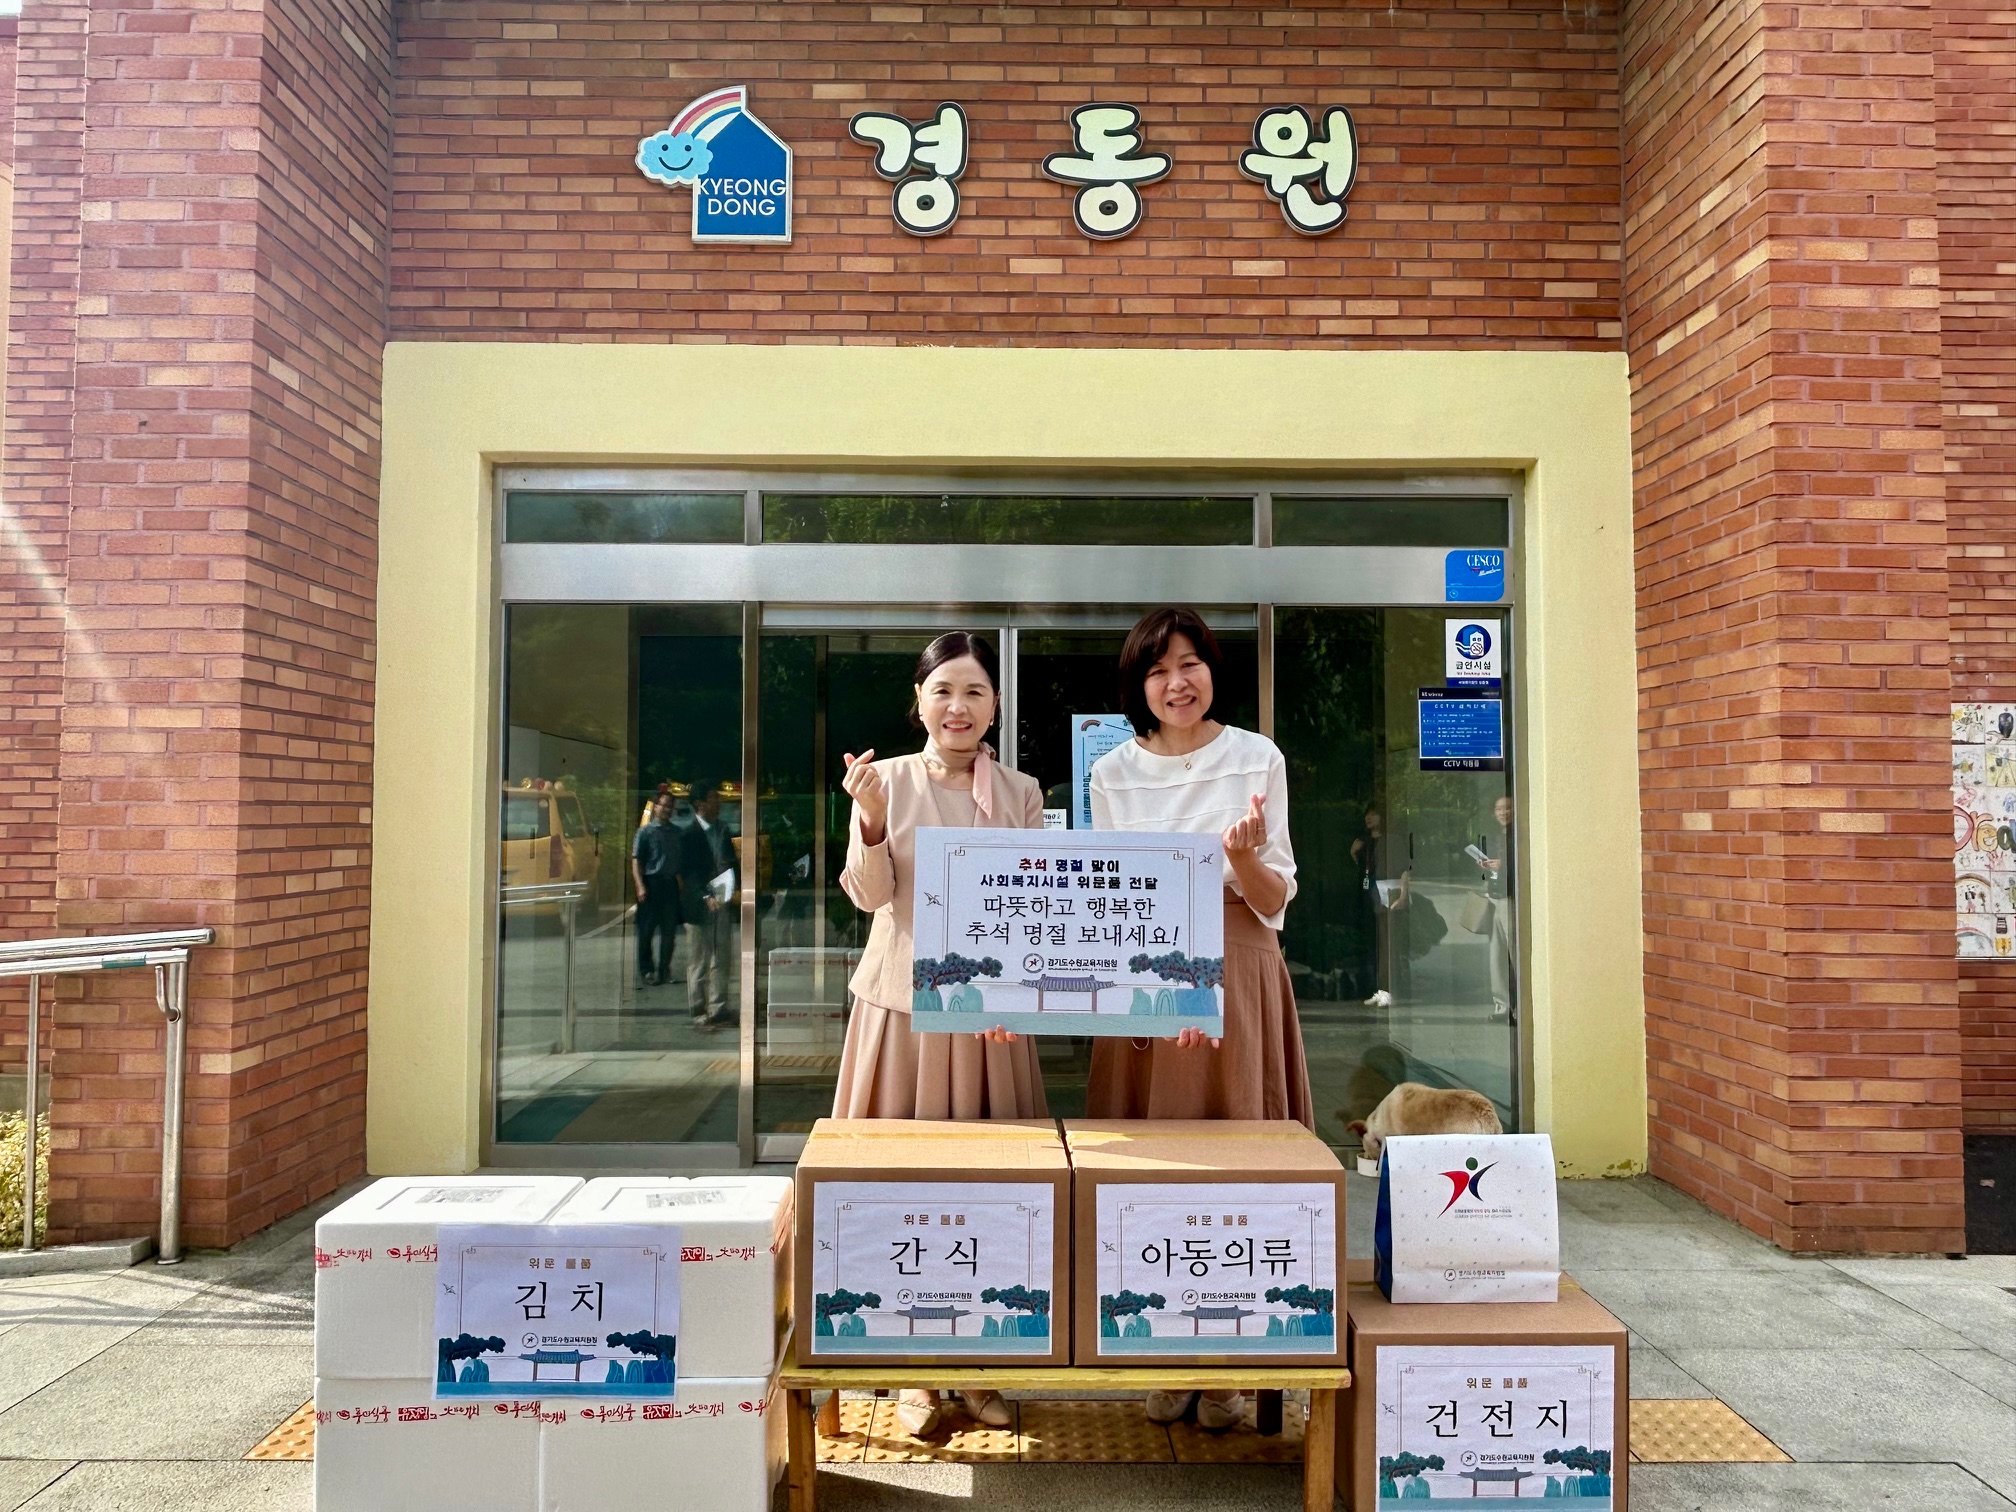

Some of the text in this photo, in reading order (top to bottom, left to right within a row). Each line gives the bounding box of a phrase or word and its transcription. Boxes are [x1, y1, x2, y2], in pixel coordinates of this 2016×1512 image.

[849, 101, 1359, 240] 경동원
[698, 178, 786, 196] KYEONG
[708, 198, 776, 215] DONG
[1466, 554, 1500, 566] CESCO
[1455, 660, 1491, 670] 금연시설
[1443, 759, 1460, 767] CCTV
[1018, 857, 1120, 873] 추석 명절 맞이
[980, 874, 1158, 890] 사회복지시설 위문품 전달
[983, 895, 1155, 920] 따뜻하고 행복한
[965, 921, 1179, 947] 추석 명절 보내세요!
[889, 1237, 978, 1277] 간식
[1141, 1237, 1297, 1277] 아동의류
[515, 1281, 603, 1321] 김치
[1426, 1399, 1567, 1438] 건전지
